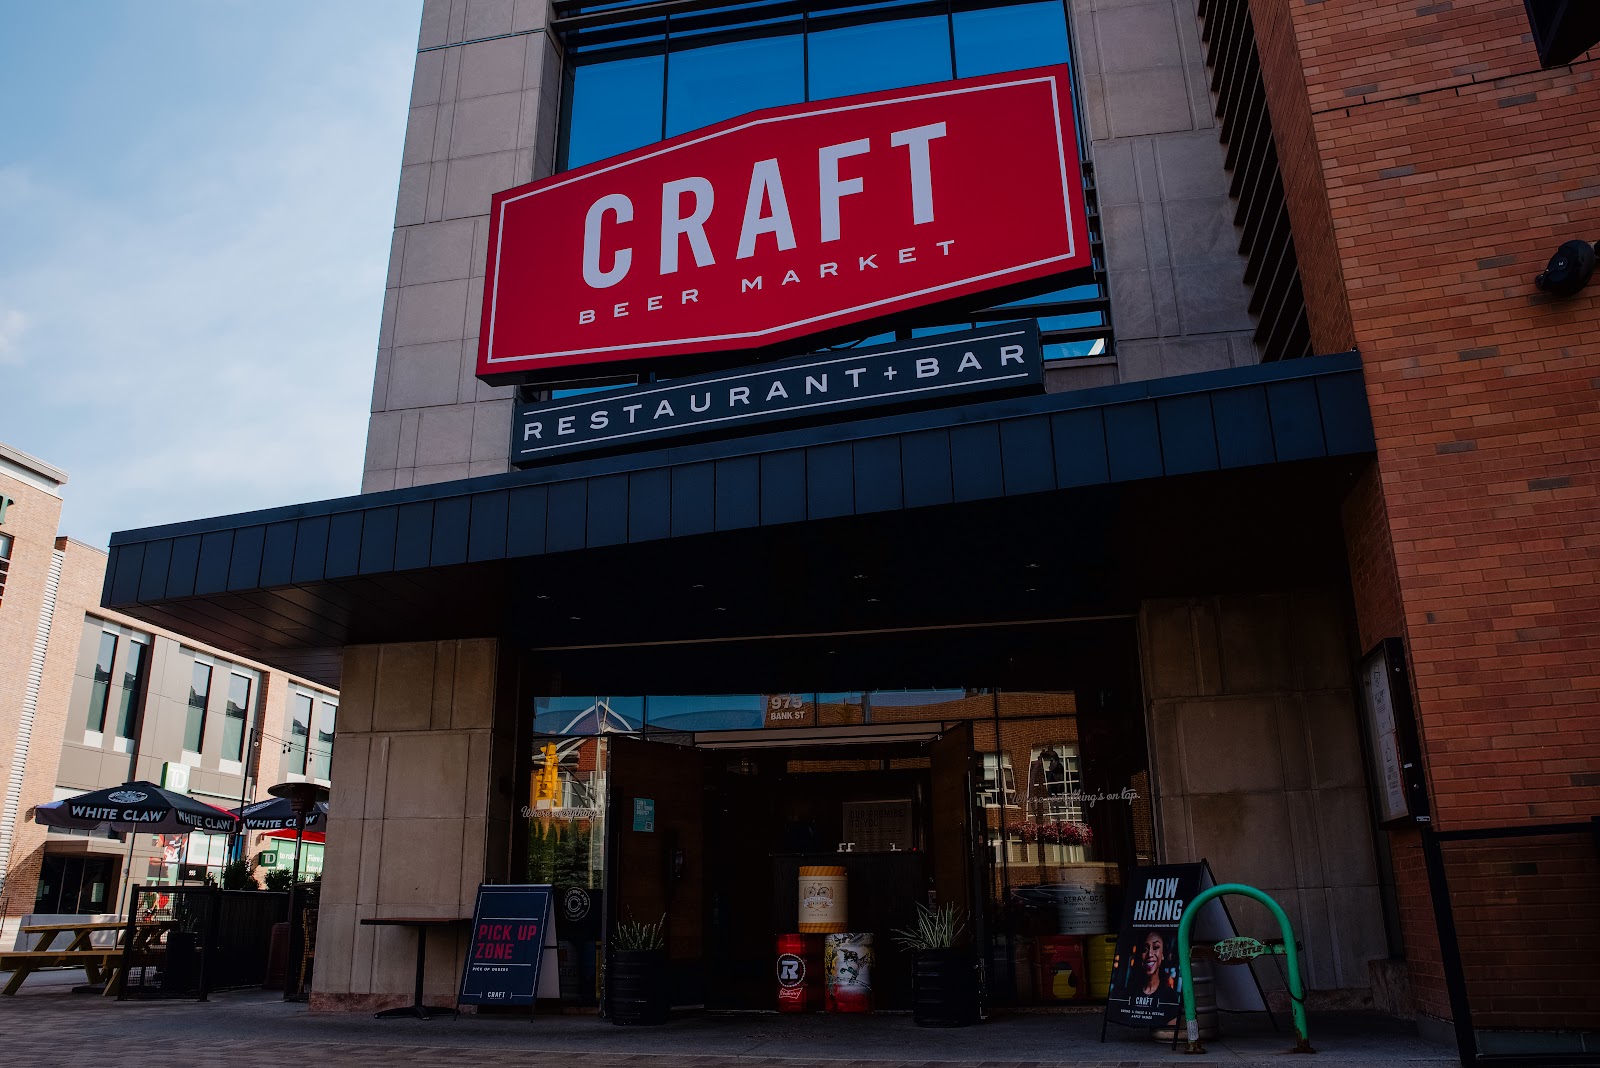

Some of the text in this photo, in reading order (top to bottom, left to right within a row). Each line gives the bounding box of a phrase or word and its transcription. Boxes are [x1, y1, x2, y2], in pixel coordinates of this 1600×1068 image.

[582, 121, 946, 289] CRAFT
[578, 239, 955, 325] BEER MARKET
[771, 695, 803, 710] 975
[770, 711, 805, 721] BANK ST
[170, 769, 188, 790] TD
[1106, 793, 1120, 801] on
[71, 805, 164, 822] WHITE CLAW
[177, 810, 231, 830] WHITE CLAW
[246, 815, 316, 829] WHITE CLW
[850, 809, 865, 820] OUR
[863, 818, 879, 828] YOU
[262, 852, 277, 865] TD
[1145, 877, 1180, 900] NOW
[1063, 896, 1087, 904] STRAY
[1089, 894, 1104, 903] DOG
[1133, 899, 1184, 921] HIRING
[478, 924, 538, 941] PICK UP
[475, 942, 515, 960] ZONE
[781, 959, 799, 980] R
[1135, 996, 1154, 1006] CRAFT
